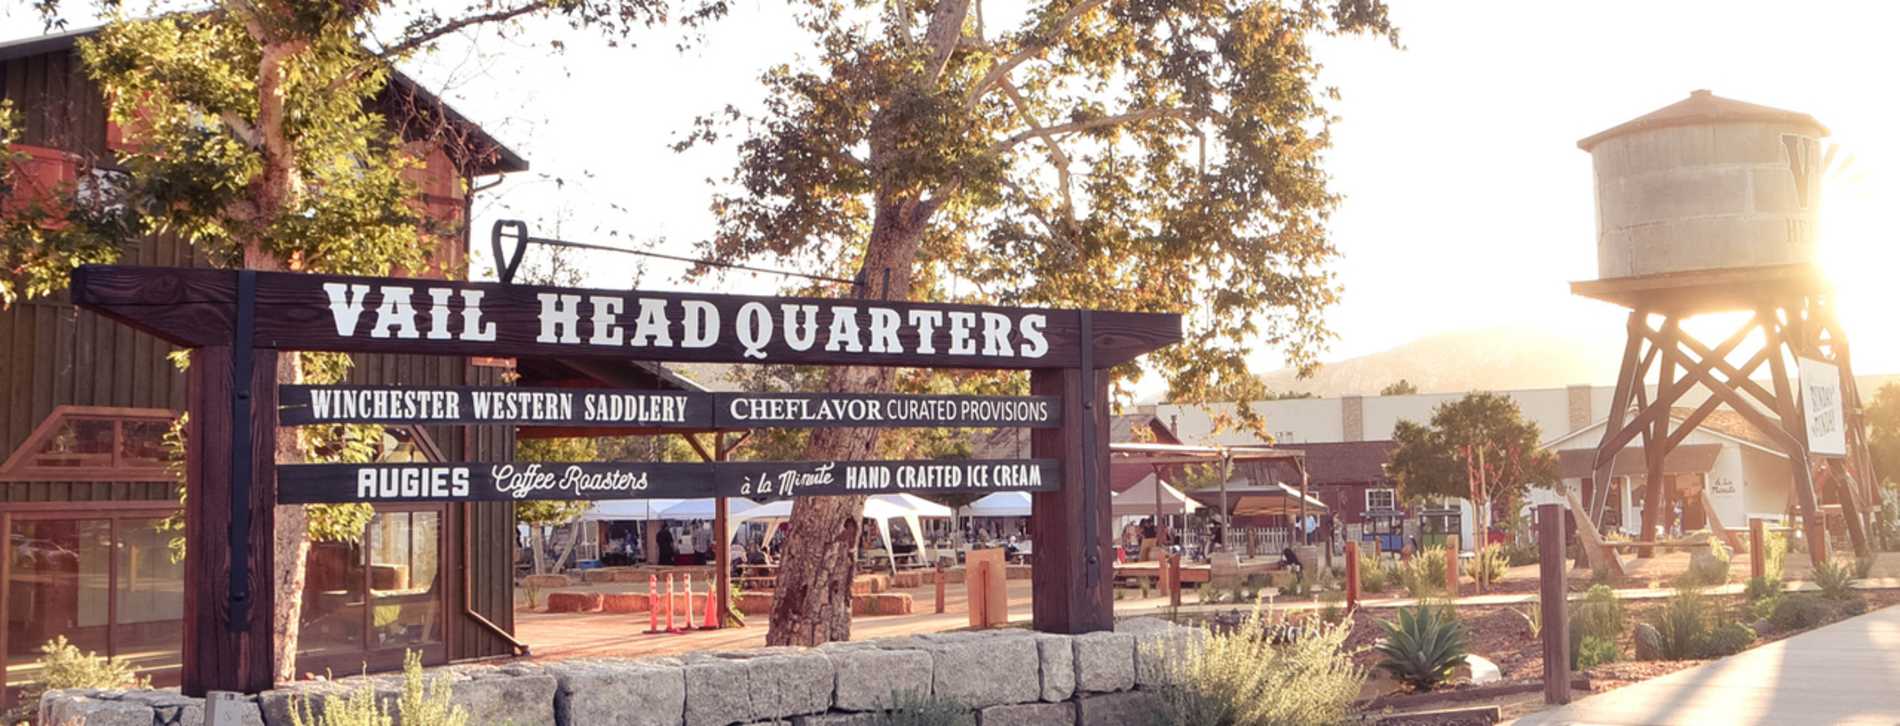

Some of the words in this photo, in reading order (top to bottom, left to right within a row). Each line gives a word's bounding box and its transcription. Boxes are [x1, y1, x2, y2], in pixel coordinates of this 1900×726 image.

[323, 282, 497, 342] VAIL
[310, 389, 460, 419] WINCHESTER
[472, 391, 573, 420] WESTERN
[584, 393, 688, 422] SADDLERY
[730, 397, 883, 421] CHEFLAVOR
[886, 399, 957, 421] CURATED
[961, 400, 1048, 422] PROVISIONS
[357, 467, 470, 498] AUGIES
[492, 463, 556, 498] Coffee
[558, 465, 648, 496] Roasters
[756, 472, 772, 494] la
[778, 461, 835, 496] Minute
[845, 465, 891, 490] HAND
[896, 465, 962, 489] CRAFTED
[967, 464, 989, 488] ICE
[992, 464, 1042, 487] CREAM
